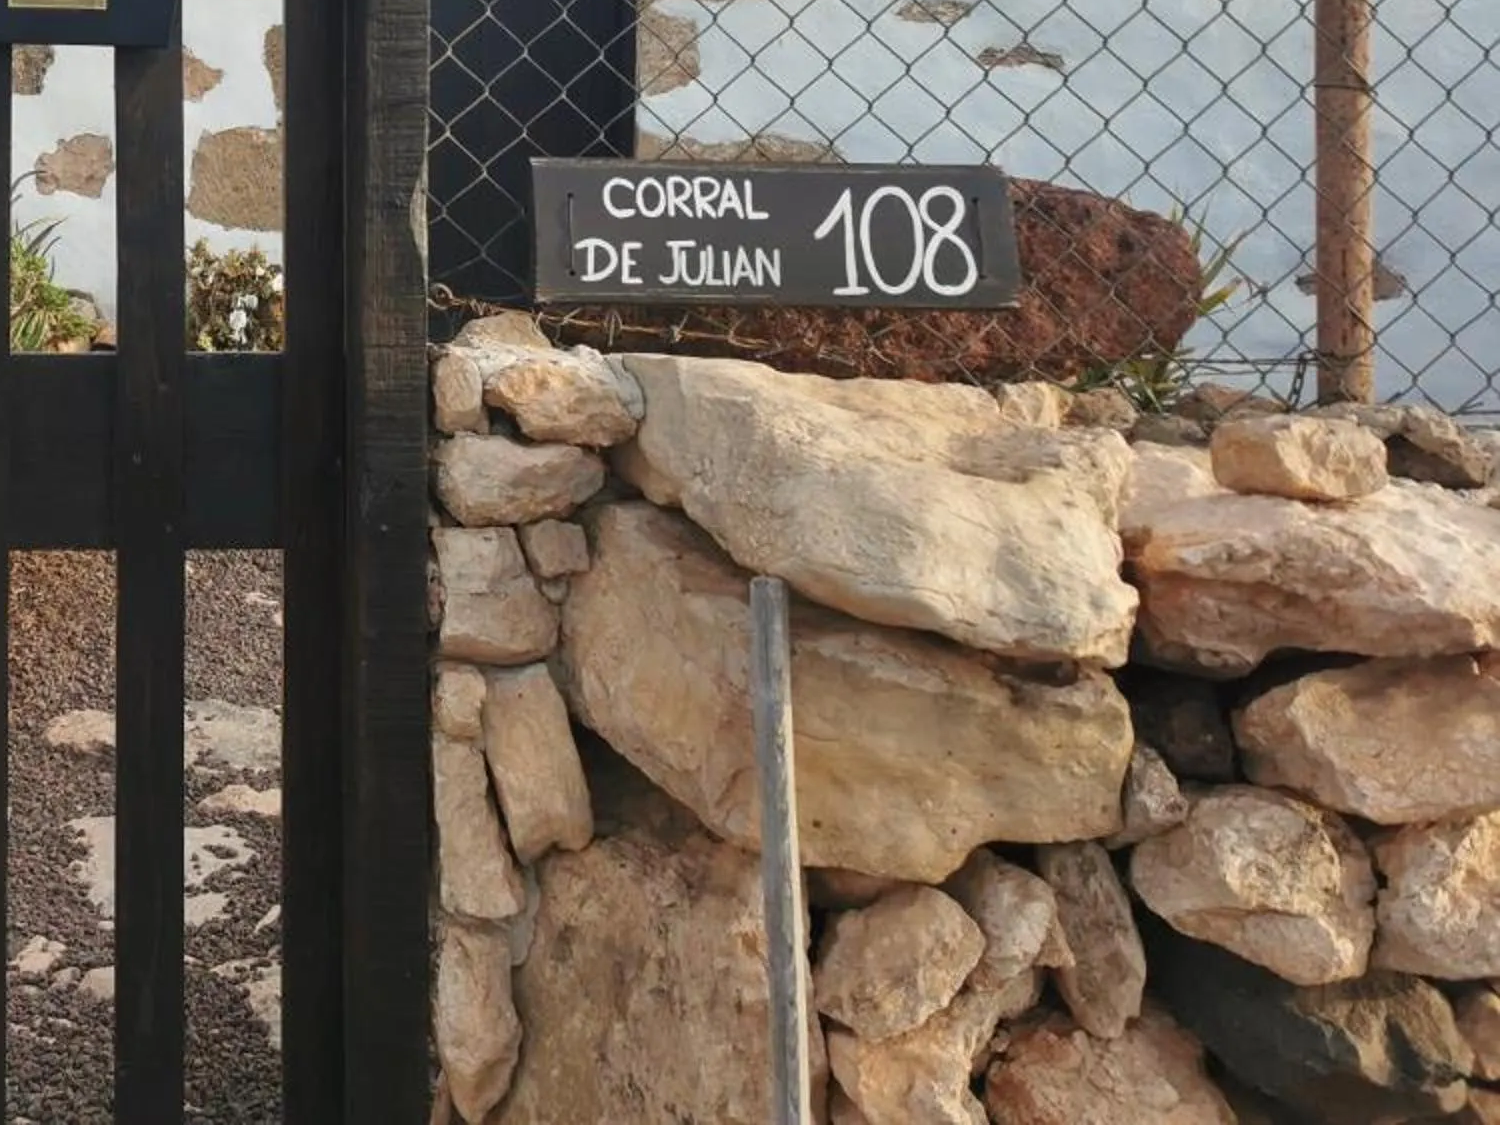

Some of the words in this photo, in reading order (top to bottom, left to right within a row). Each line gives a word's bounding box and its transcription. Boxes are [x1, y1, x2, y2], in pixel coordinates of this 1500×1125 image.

[602, 175, 770, 220] CORRAL
[574, 237, 644, 285] DE
[658, 239, 782, 287] JULIAN
[813, 184, 979, 296] 108
